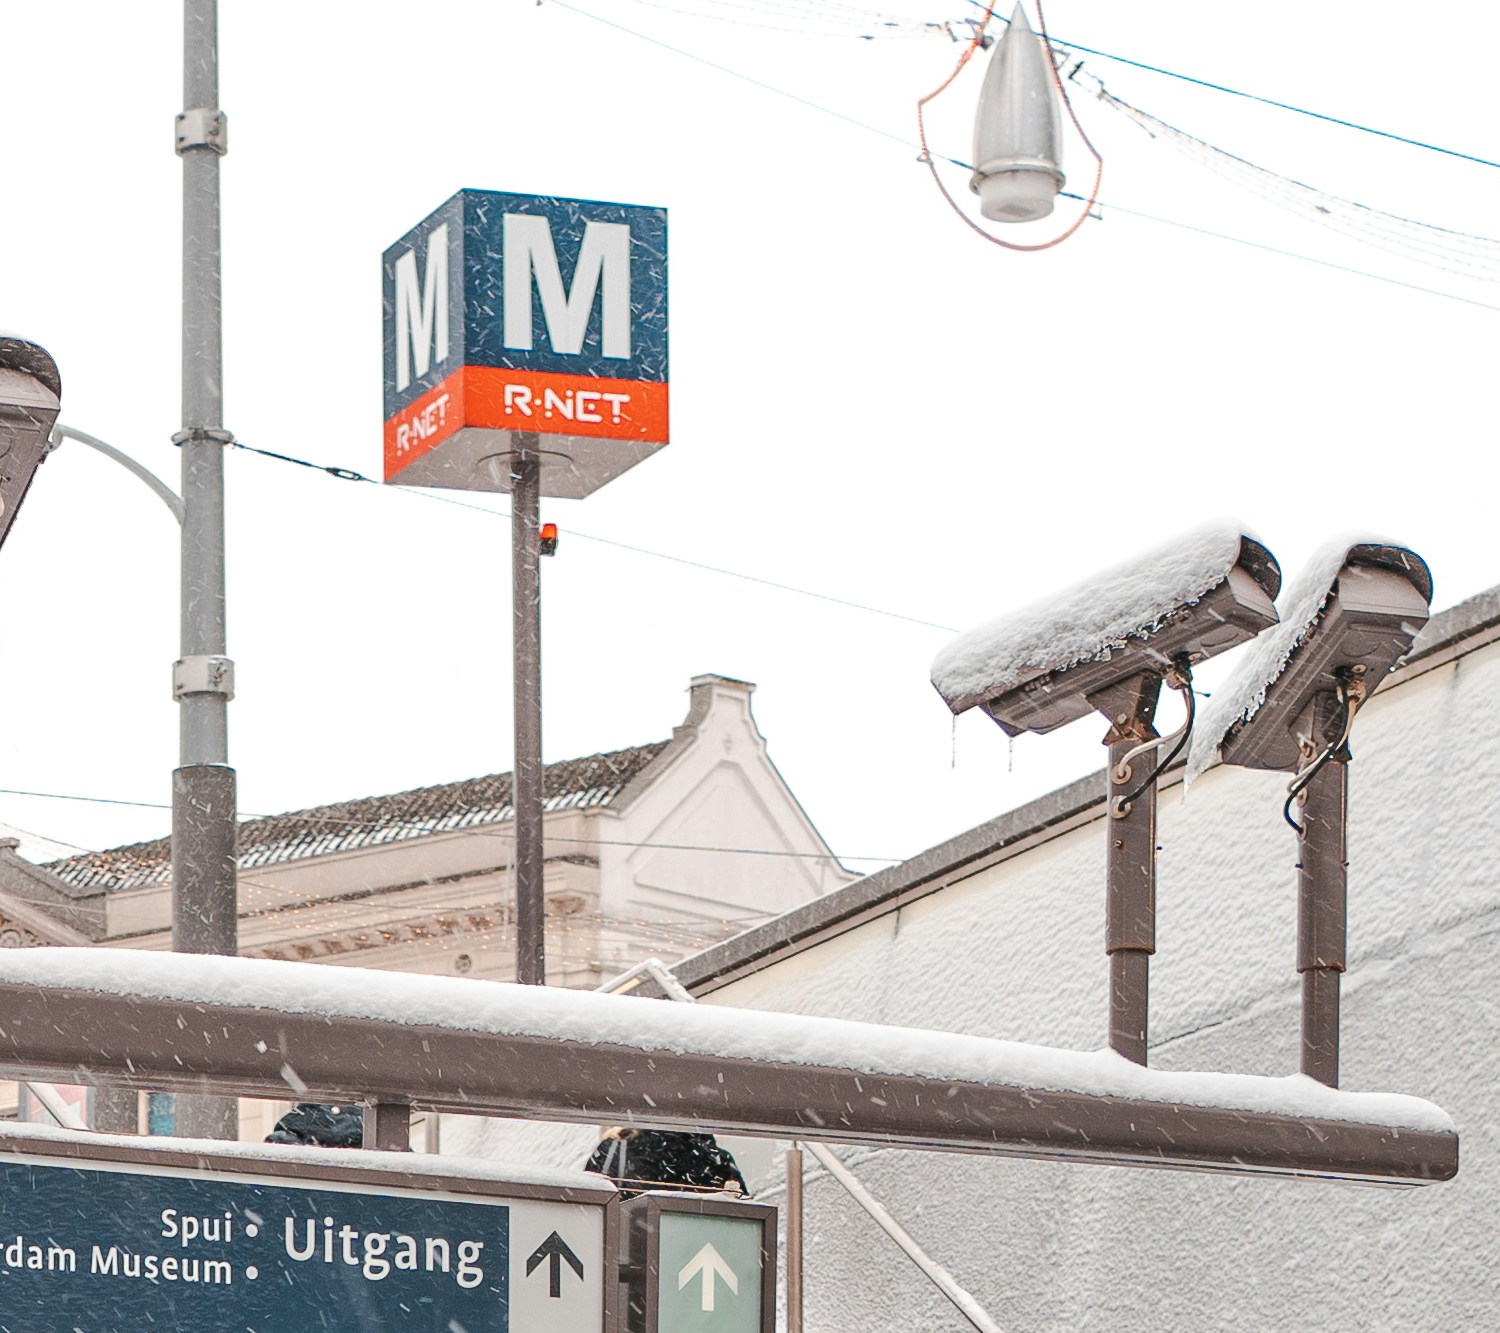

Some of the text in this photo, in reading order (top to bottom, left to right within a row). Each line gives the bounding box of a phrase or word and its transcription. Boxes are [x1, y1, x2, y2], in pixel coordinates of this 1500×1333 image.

[395, 222, 450, 393] M
[503, 212, 632, 360] M
[160, 1207, 233, 1248] Spui
[285, 1216, 485, 1289] Uitgang
[90, 1244, 233, 1286] Museum
